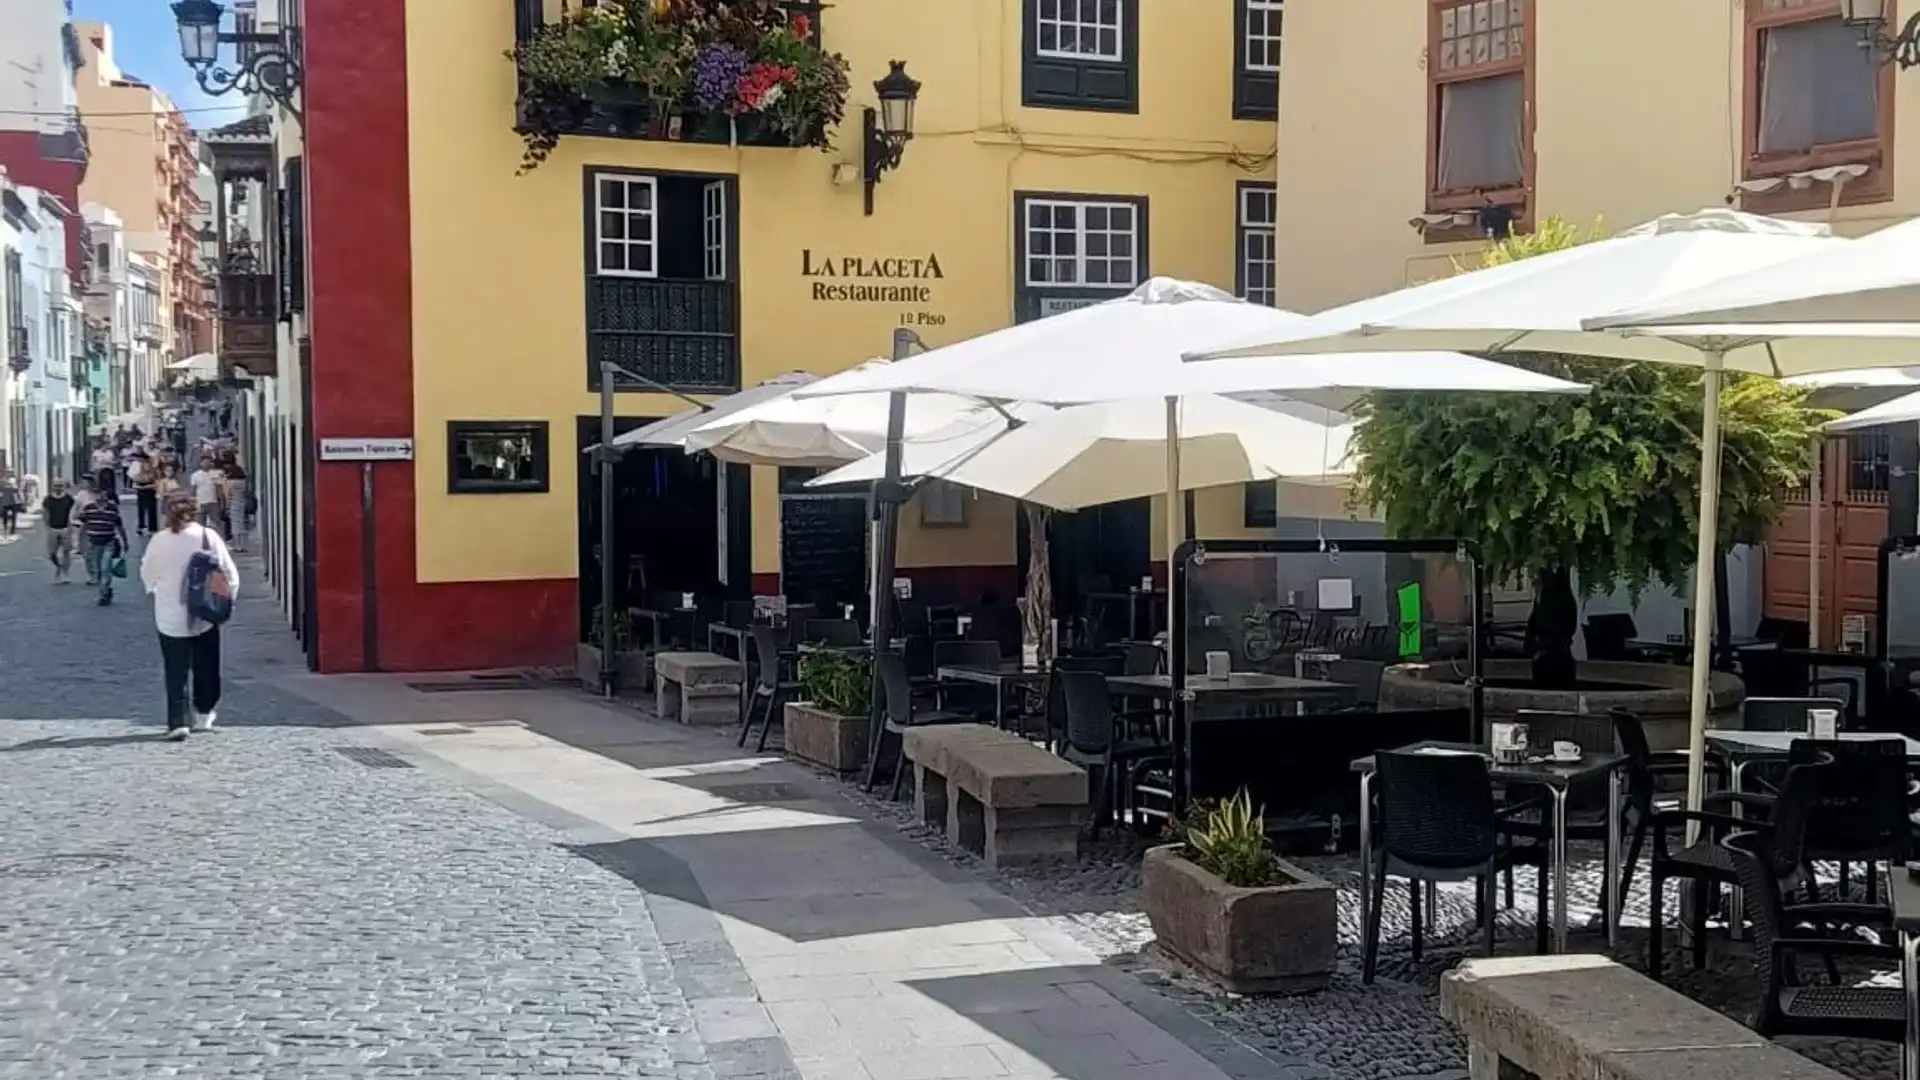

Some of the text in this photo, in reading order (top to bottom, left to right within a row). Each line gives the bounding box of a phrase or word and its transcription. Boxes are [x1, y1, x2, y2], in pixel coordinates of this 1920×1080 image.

[842, 252, 944, 279] PLACETA
[812, 282, 931, 302] Restaurante
[917, 312, 946, 325] Piso
